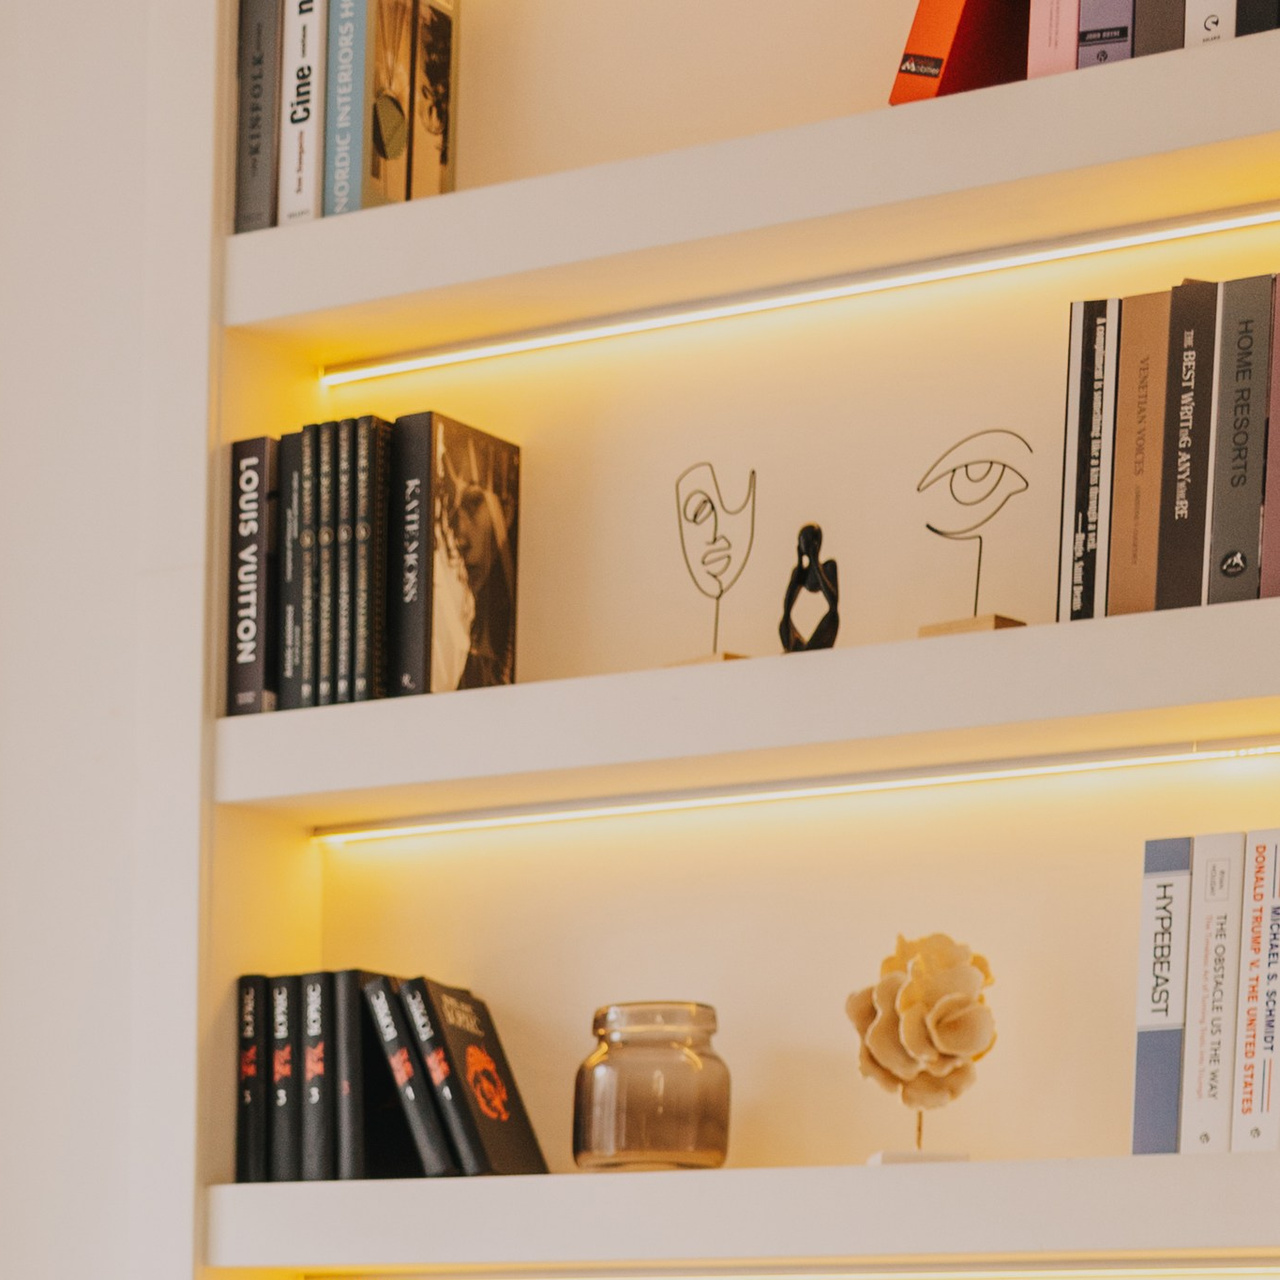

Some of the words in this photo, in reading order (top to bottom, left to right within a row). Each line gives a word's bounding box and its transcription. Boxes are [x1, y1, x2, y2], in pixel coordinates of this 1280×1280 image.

[248, 53, 264, 156] KINFOLK
[290, 65, 312, 124] Cine
[335, 22, 355, 129] INTERIORS
[333, 133, 352, 213] NORDIC
[1182, 351, 1196, 389] BEST
[1235, 319, 1254, 381] HOME
[1136, 356, 1150, 424] VENETIAN
[1133, 427, 1145, 476] VOICES
[1231, 387, 1251, 488] RESORTS
[238, 456, 259, 537] LOUIS
[236, 544, 259, 664] VUITTON
[1253, 844, 1267, 902] DONALD
[1151, 884, 1174, 1017] HYPEBEAST
[1215, 914, 1227, 940] THE
[1251, 906, 1264, 955] TRUMP
[1268, 906, 1280, 968] MICHAEL
[1212, 944, 1226, 1012] OBSTACLE
[1247, 975, 1259, 1002] THE
[1209, 1040, 1221, 1064] THE
[1244, 1007, 1258, 1059] UNITED
[1264, 990, 1277, 1052] SCHMIDT
[1208, 1070, 1219, 1099] WAY
[1241, 1063, 1255, 1115] STATES
